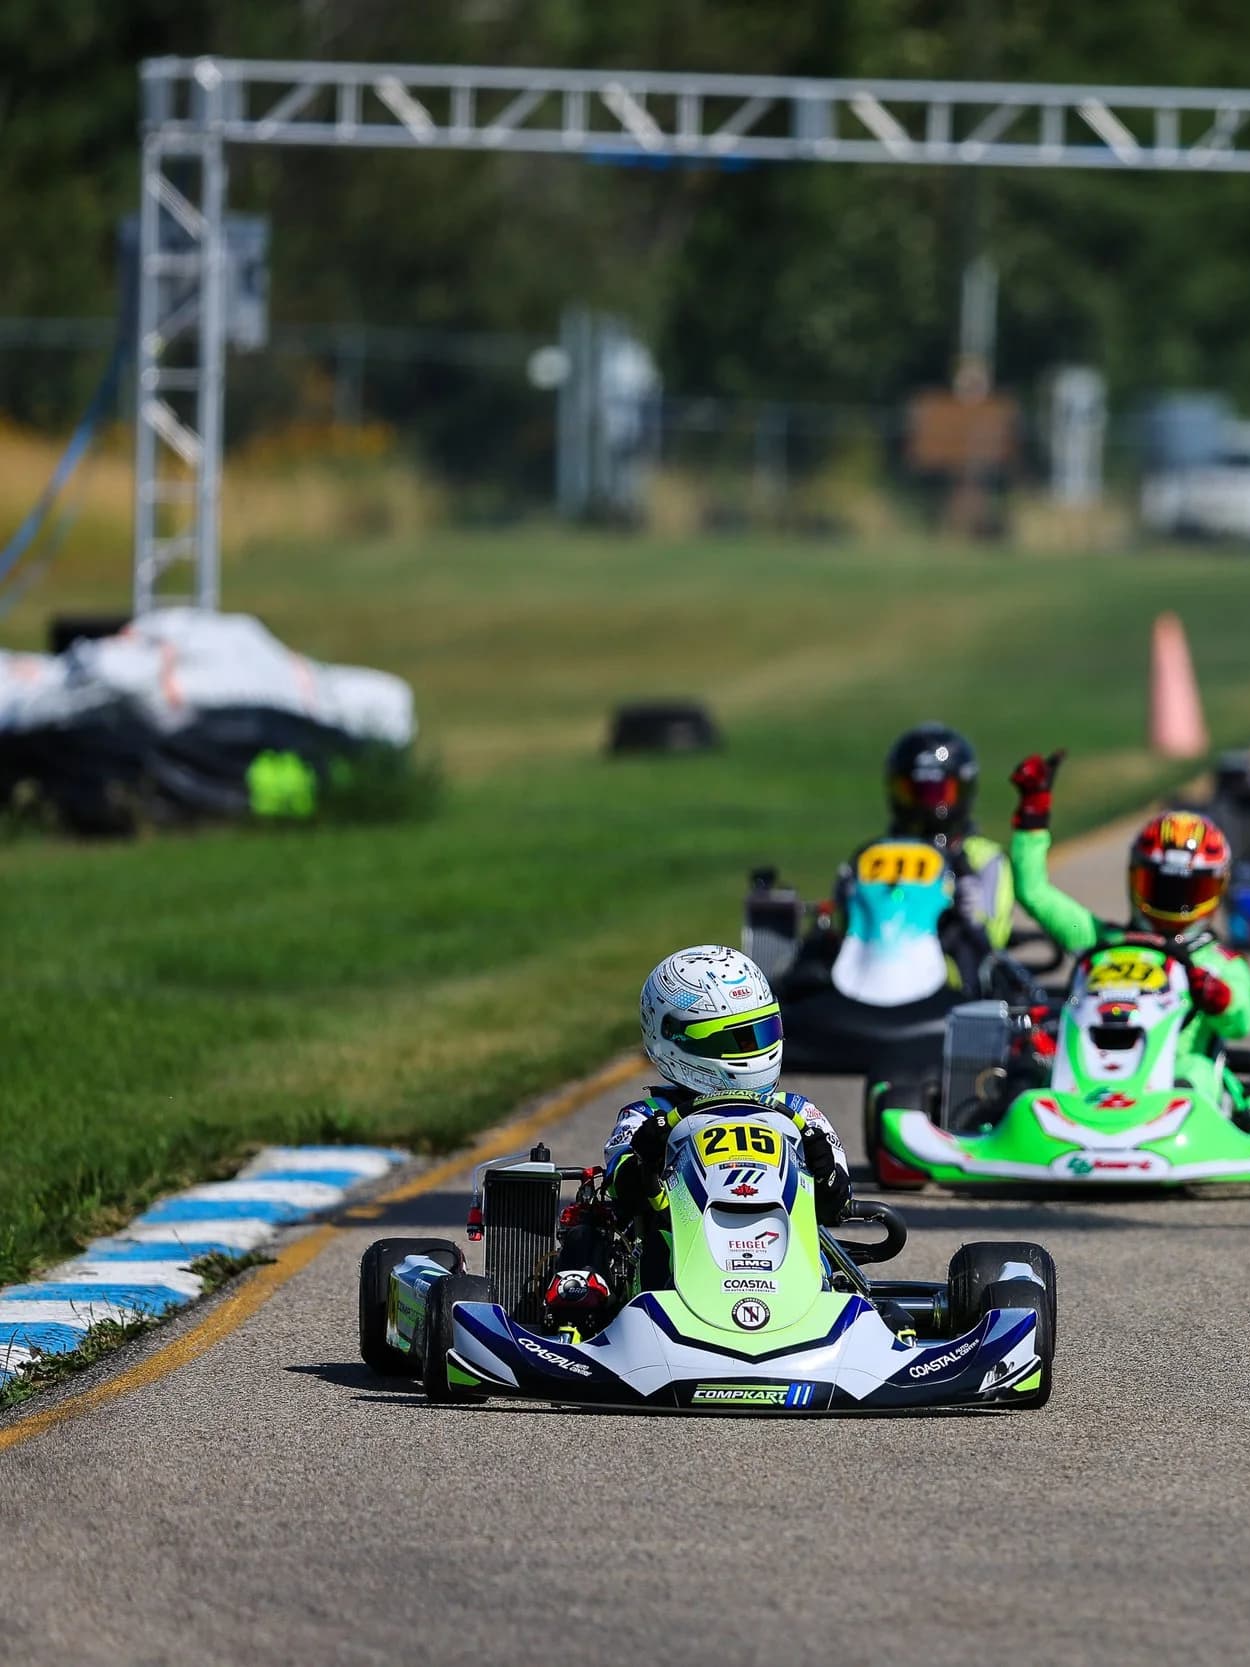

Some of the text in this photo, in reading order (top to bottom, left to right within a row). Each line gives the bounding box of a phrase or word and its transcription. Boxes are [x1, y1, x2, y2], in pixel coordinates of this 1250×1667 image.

[732, 988, 751, 997] BELL
[703, 1126, 776, 1157] 215
[729, 1241, 766, 1249] FEIGEL
[723, 1279, 776, 1290] COASTAL
[518, 1338, 575, 1370] COASTAL
[909, 1351, 961, 1379] COASTAL
[693, 1390, 788, 1404] COMPKART
